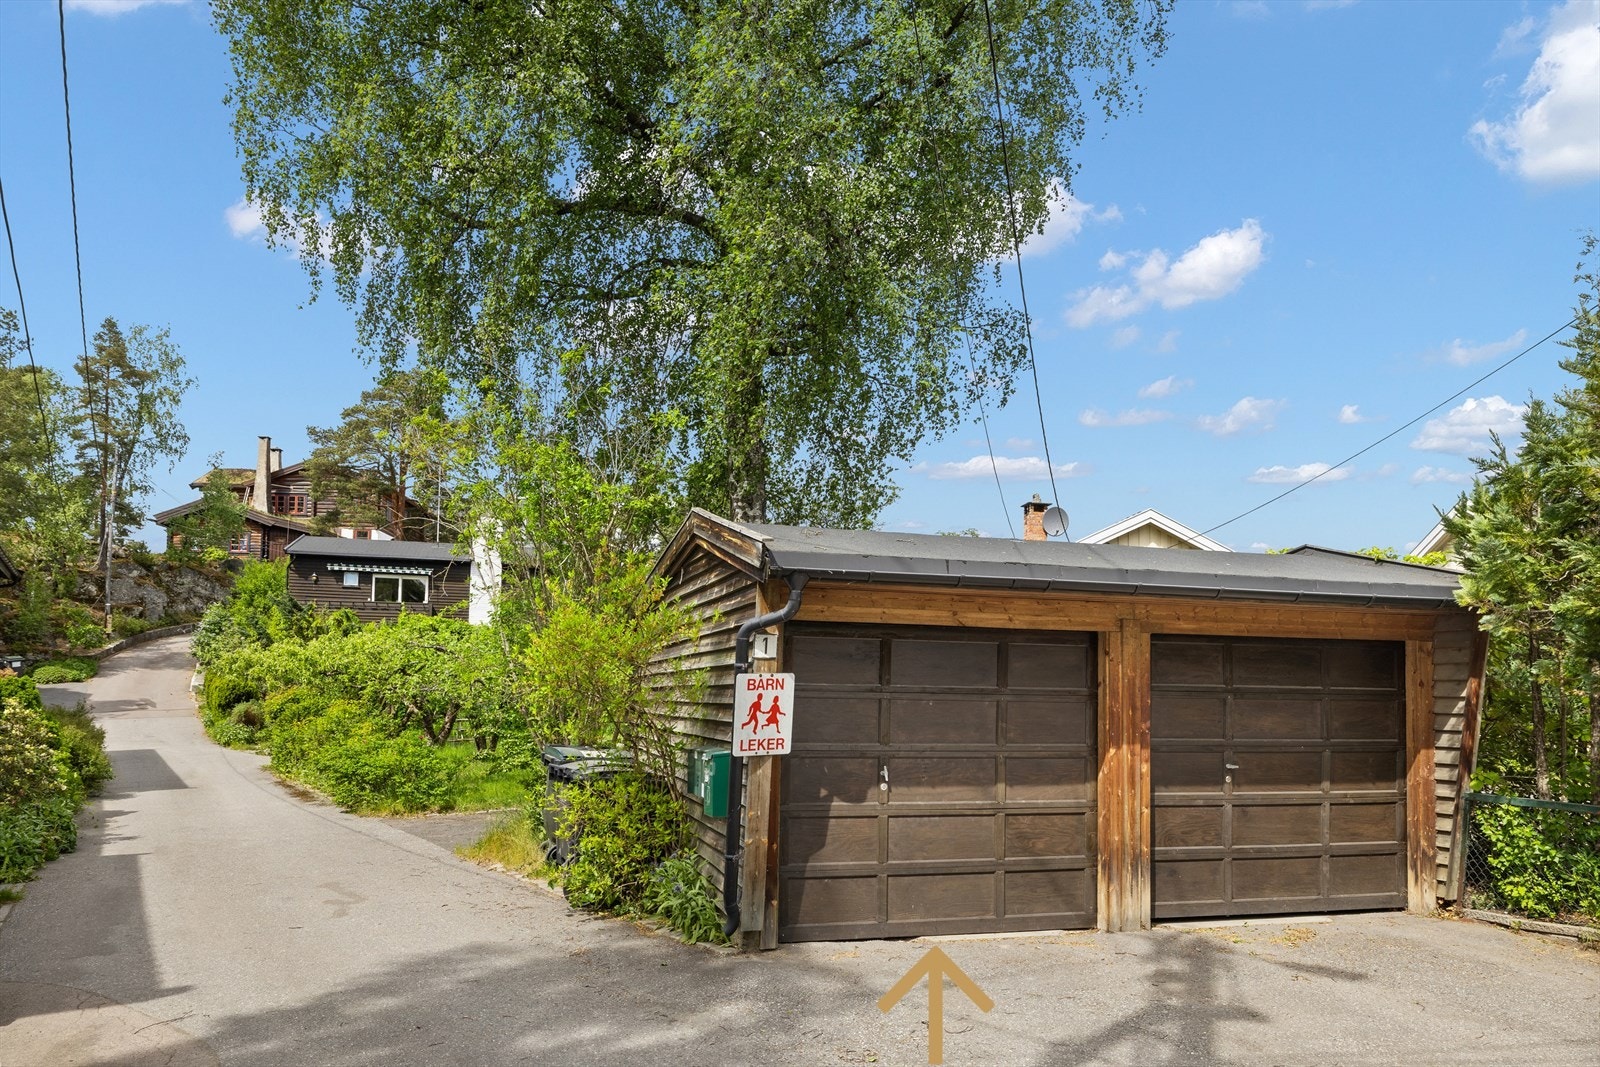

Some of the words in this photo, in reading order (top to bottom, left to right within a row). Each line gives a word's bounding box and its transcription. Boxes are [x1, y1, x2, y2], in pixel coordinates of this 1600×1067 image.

[763, 637, 769, 655] 1
[747, 678, 785, 691] BARN
[740, 738, 785, 752] LEKER
